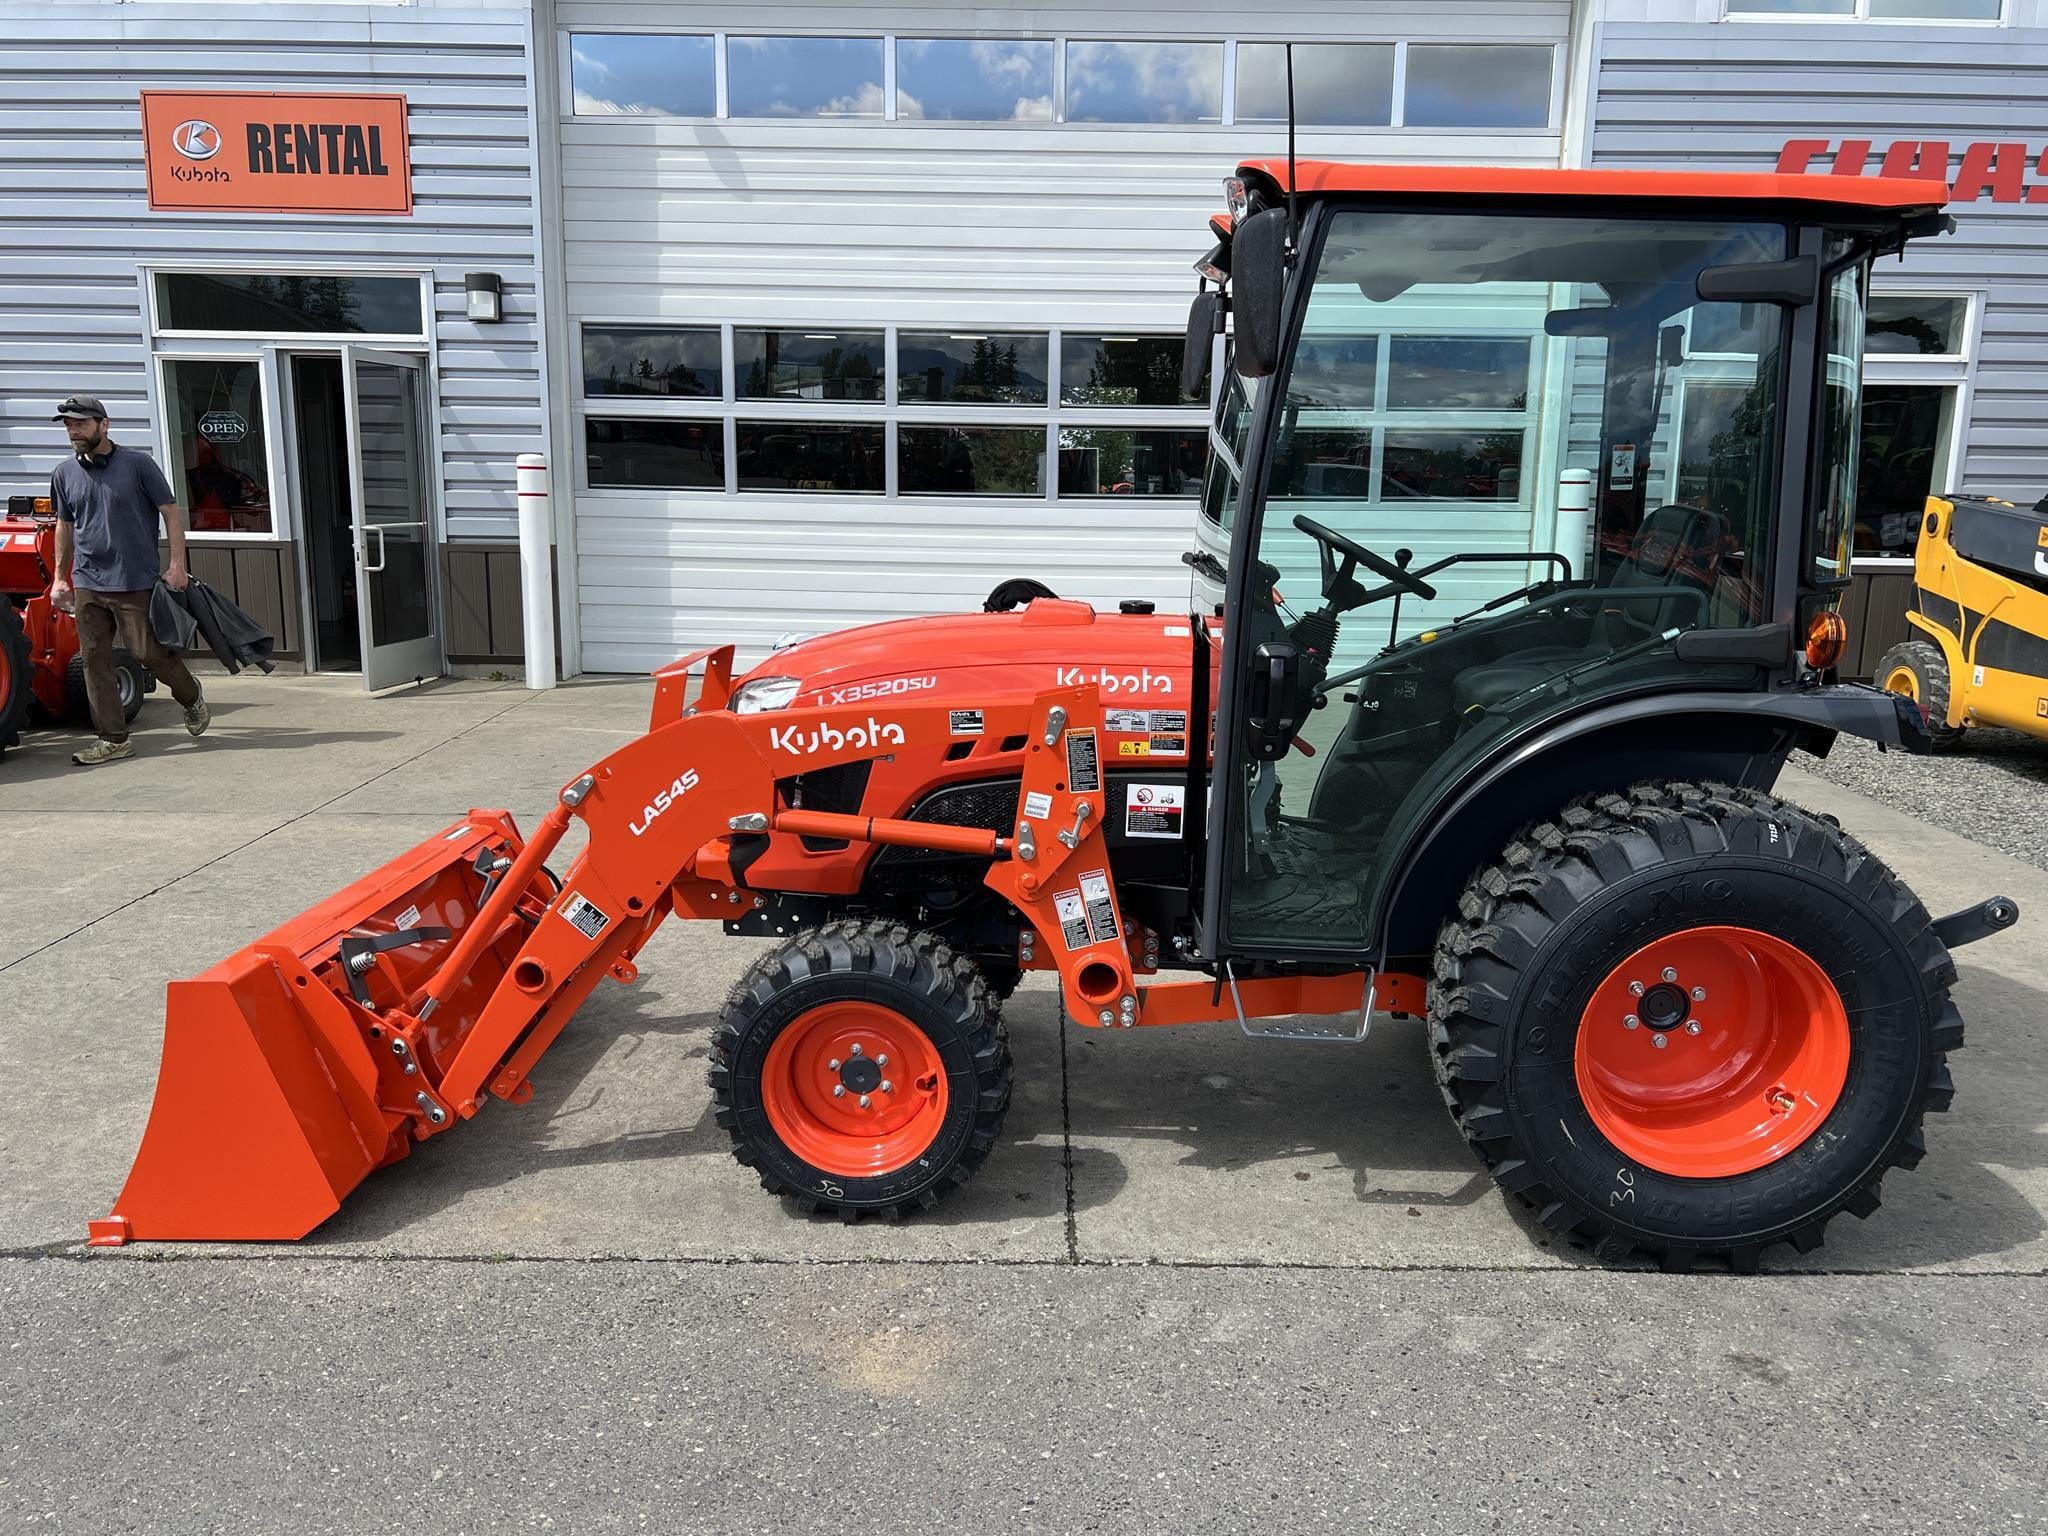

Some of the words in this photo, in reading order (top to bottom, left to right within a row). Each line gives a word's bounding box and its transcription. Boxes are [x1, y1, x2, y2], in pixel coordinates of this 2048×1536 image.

[246, 123, 389, 176] RENTAL
[170, 166, 231, 183] Kubota
[201, 423, 245, 433] OPEN
[817, 676, 937, 708] LX3520SU
[770, 717, 906, 755] Kubota
[628, 768, 700, 836] LA545
